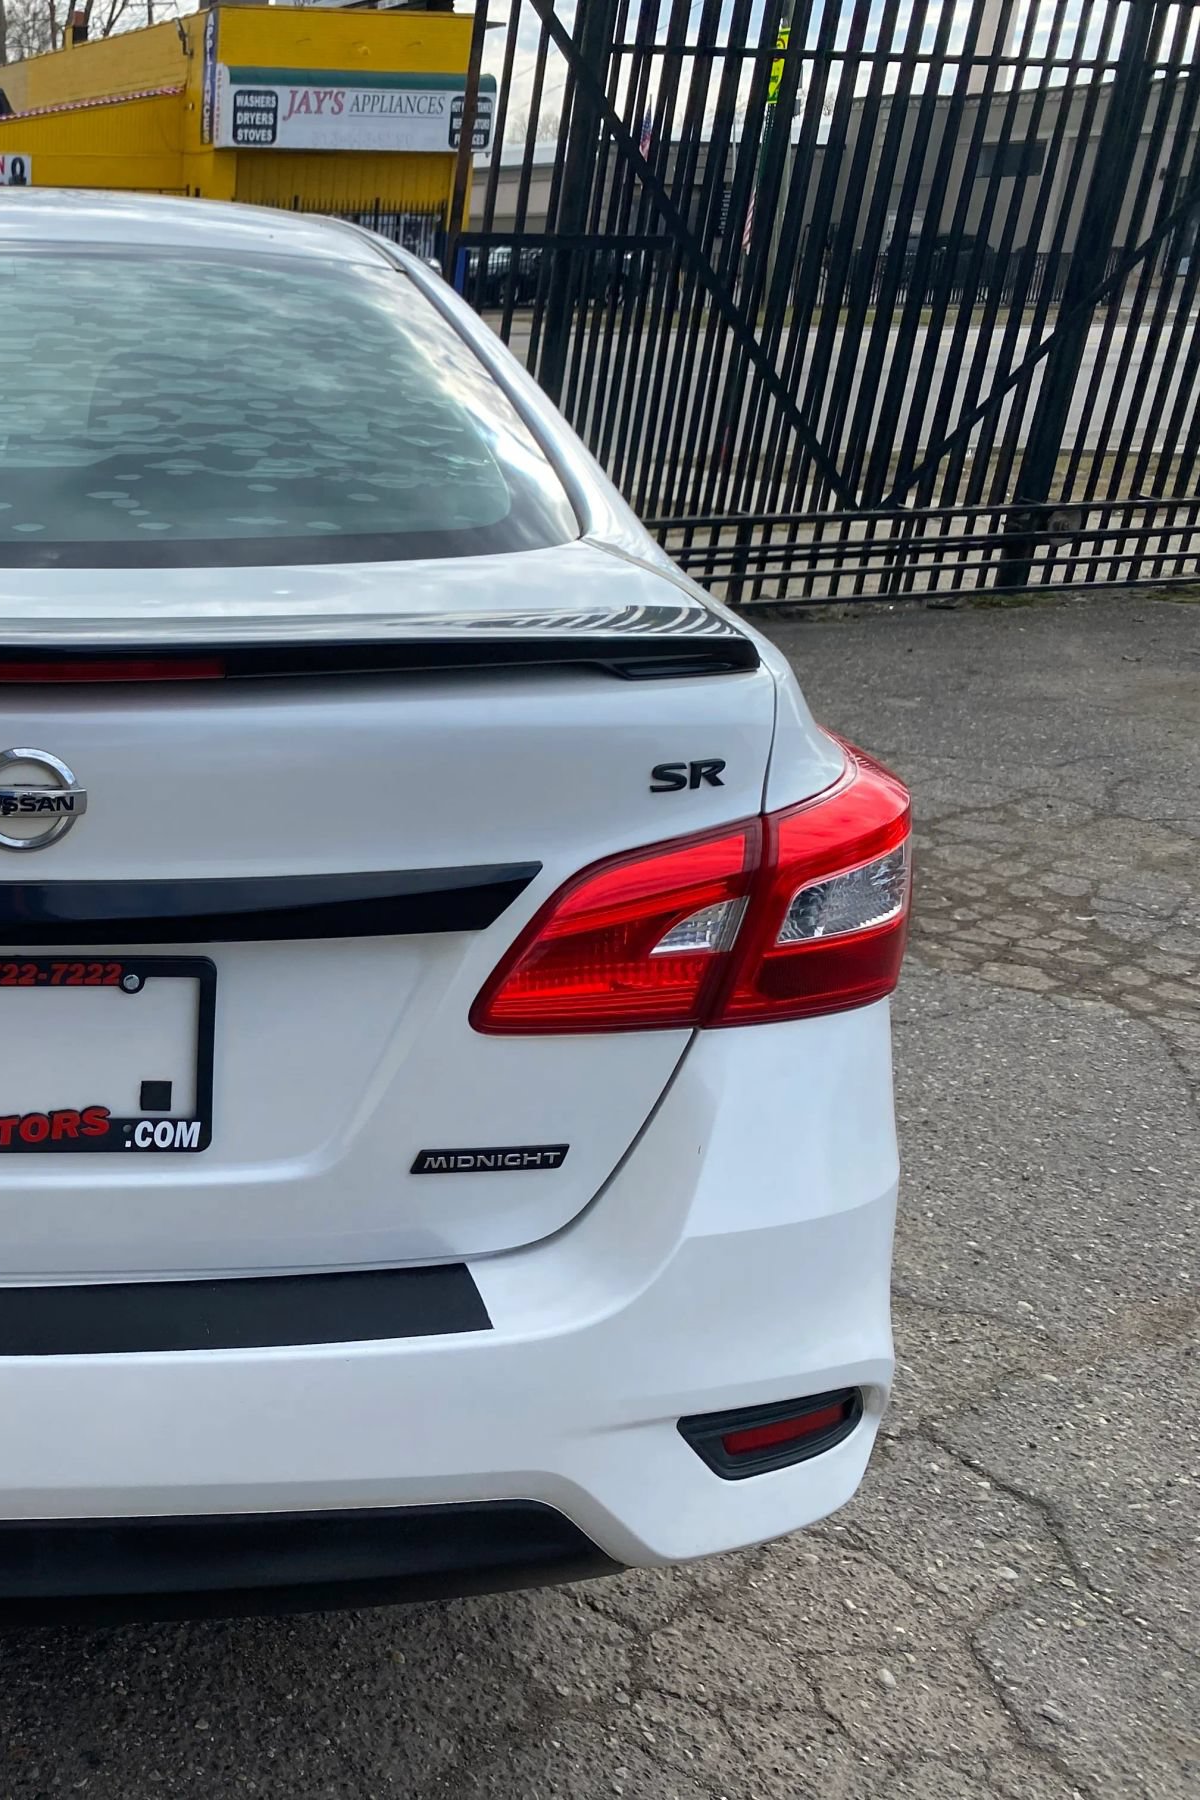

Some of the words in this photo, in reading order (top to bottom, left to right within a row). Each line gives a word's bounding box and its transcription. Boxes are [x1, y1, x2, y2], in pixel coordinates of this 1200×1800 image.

[235, 95, 277, 108] WASHERS
[282, 89, 346, 121] JAY'S
[349, 94, 446, 115] APPLIANCES
[236, 111, 274, 126] DRYERS
[236, 129, 273, 142] STOVES
[649, 758, 726, 793] SR
[124, 1120, 201, 1149] .COM
[423, 1151, 561, 1169] MIDNIGHT
